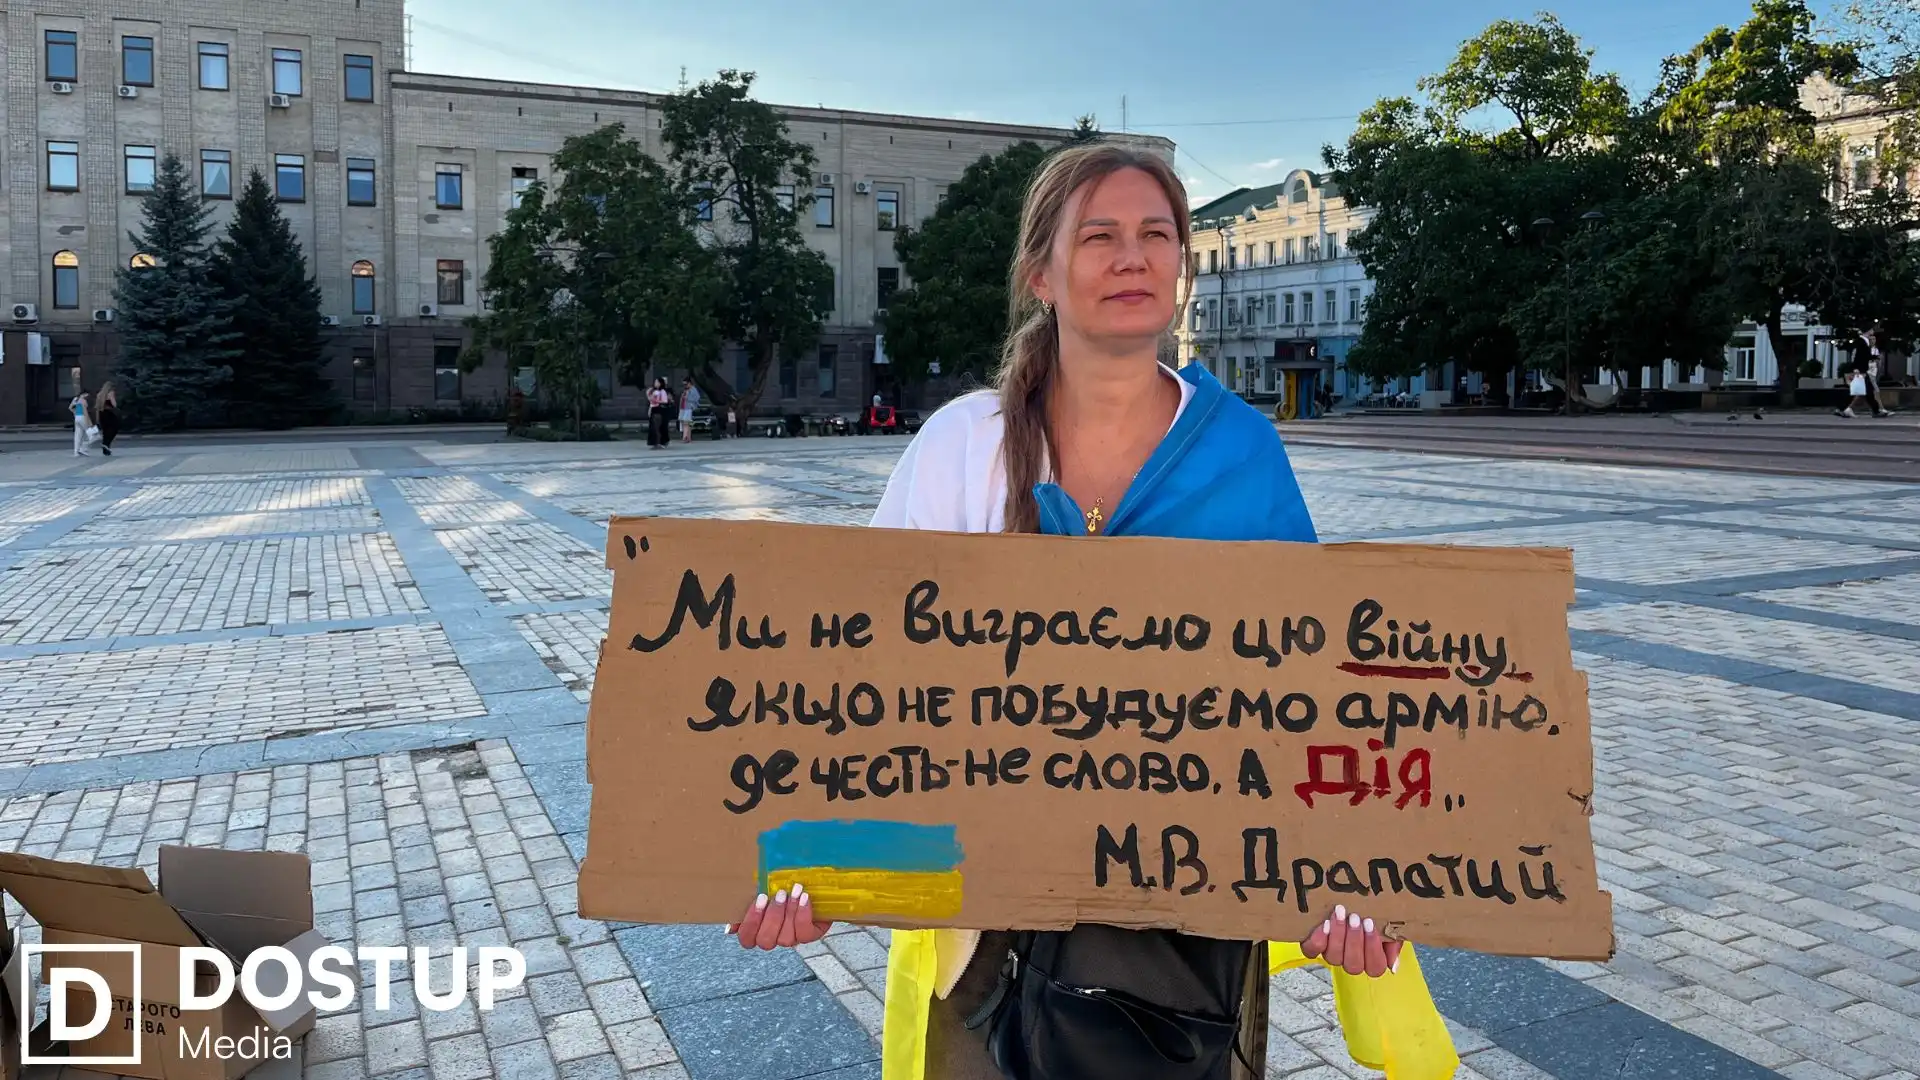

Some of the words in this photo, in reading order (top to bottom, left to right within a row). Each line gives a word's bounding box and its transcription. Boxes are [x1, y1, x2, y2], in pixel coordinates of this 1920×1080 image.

[811, 613, 873, 648] не
[1233, 615, 1325, 667] цю
[1231, 826, 1566, 913] Драпатий
[123, 1017, 166, 1036] ЛВА
